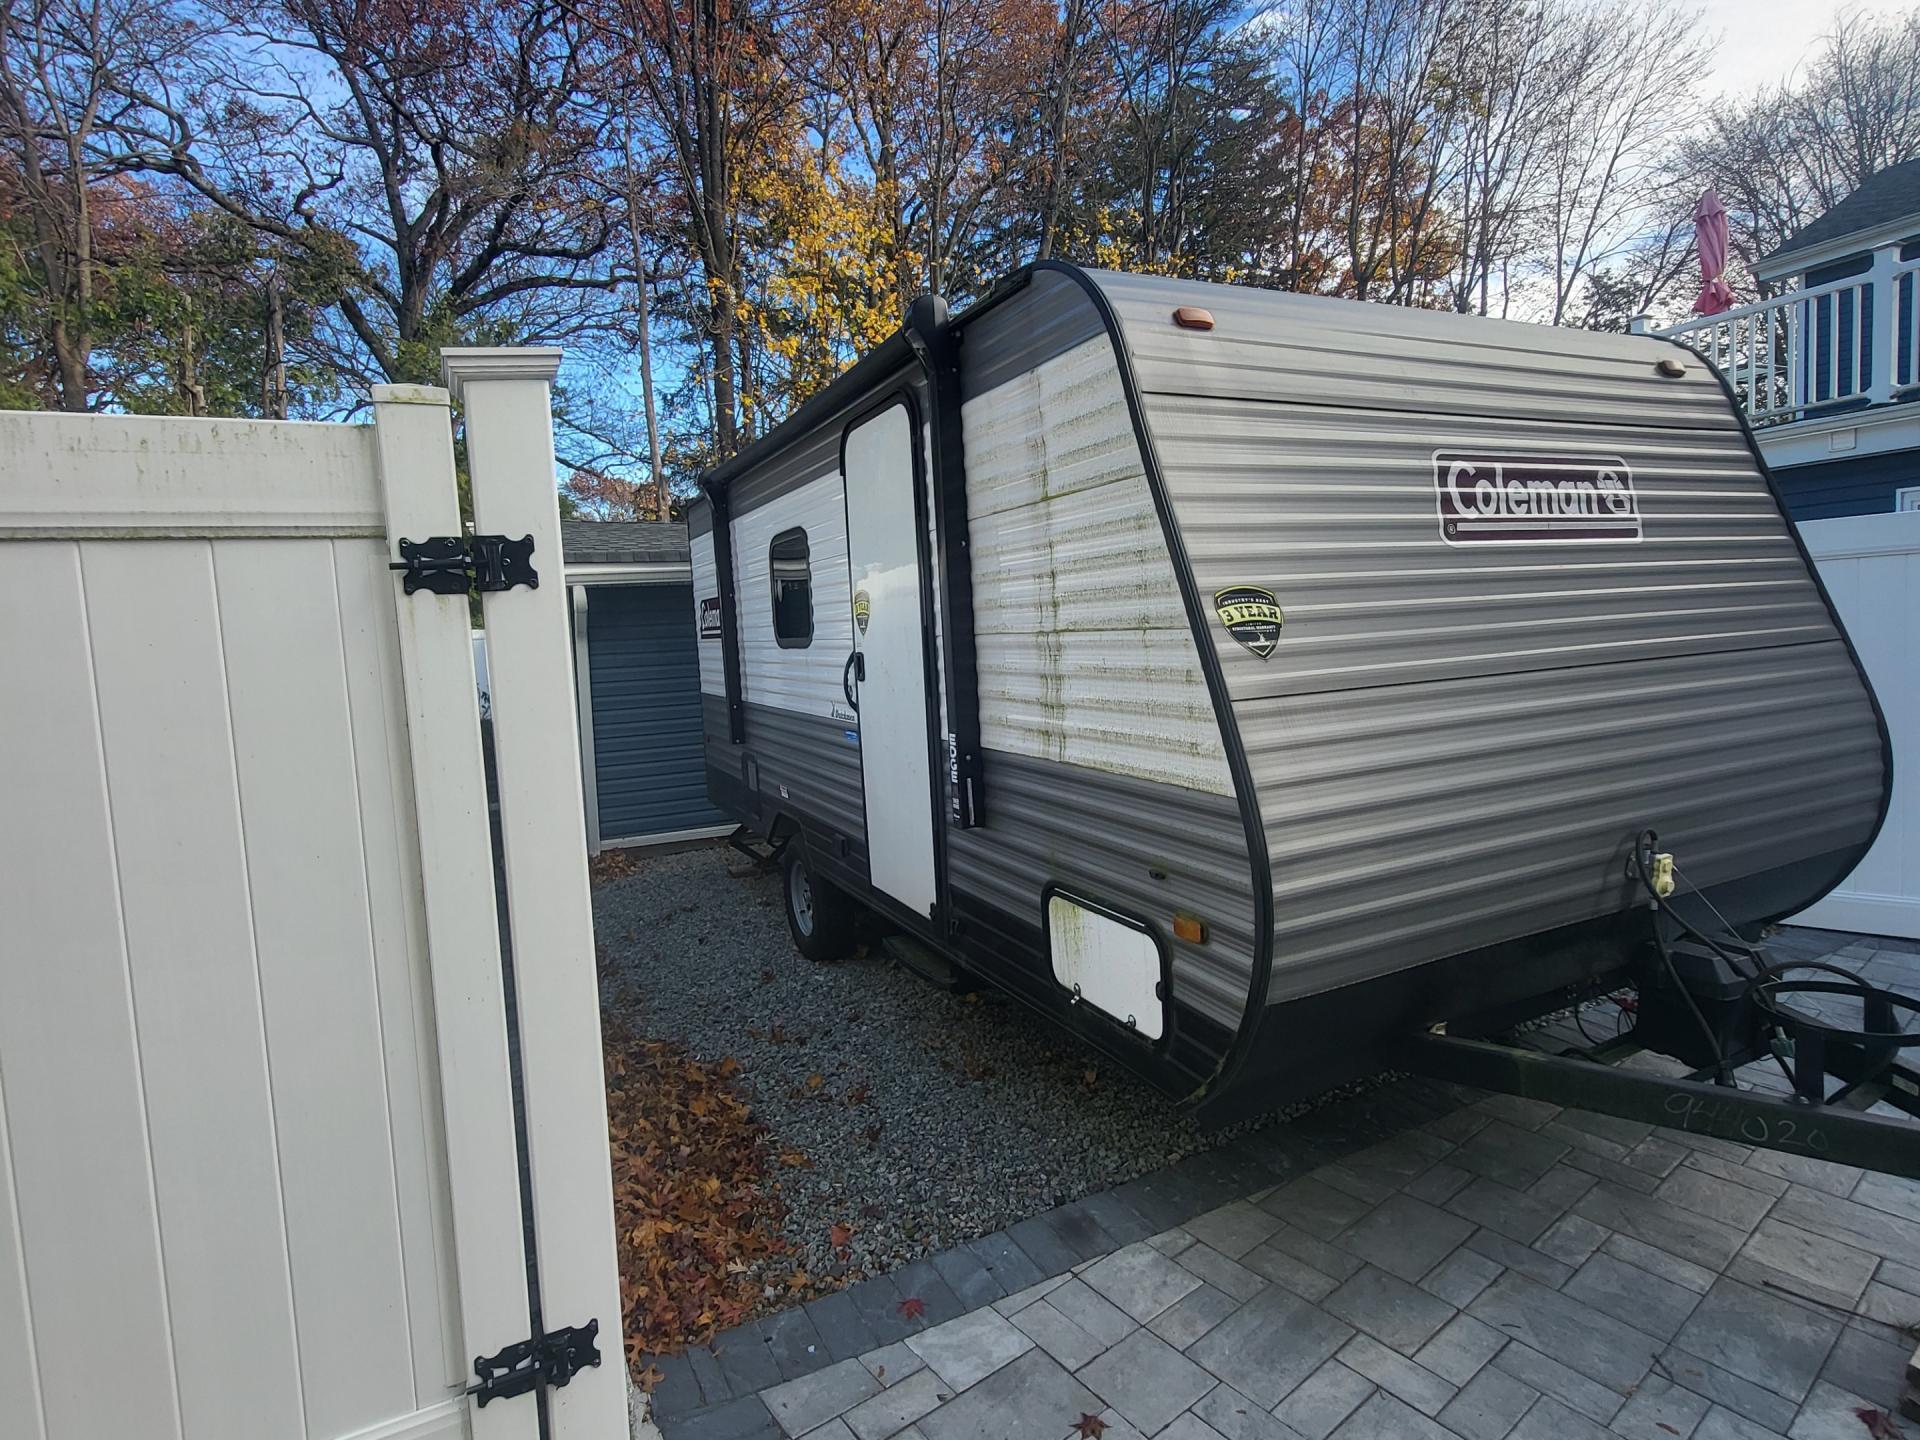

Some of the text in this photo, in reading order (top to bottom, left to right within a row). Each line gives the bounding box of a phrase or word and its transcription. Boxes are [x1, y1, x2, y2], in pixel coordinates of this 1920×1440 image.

[1447, 460, 1599, 519] Coleman
[1222, 606, 1279, 622] 3 YEAR
